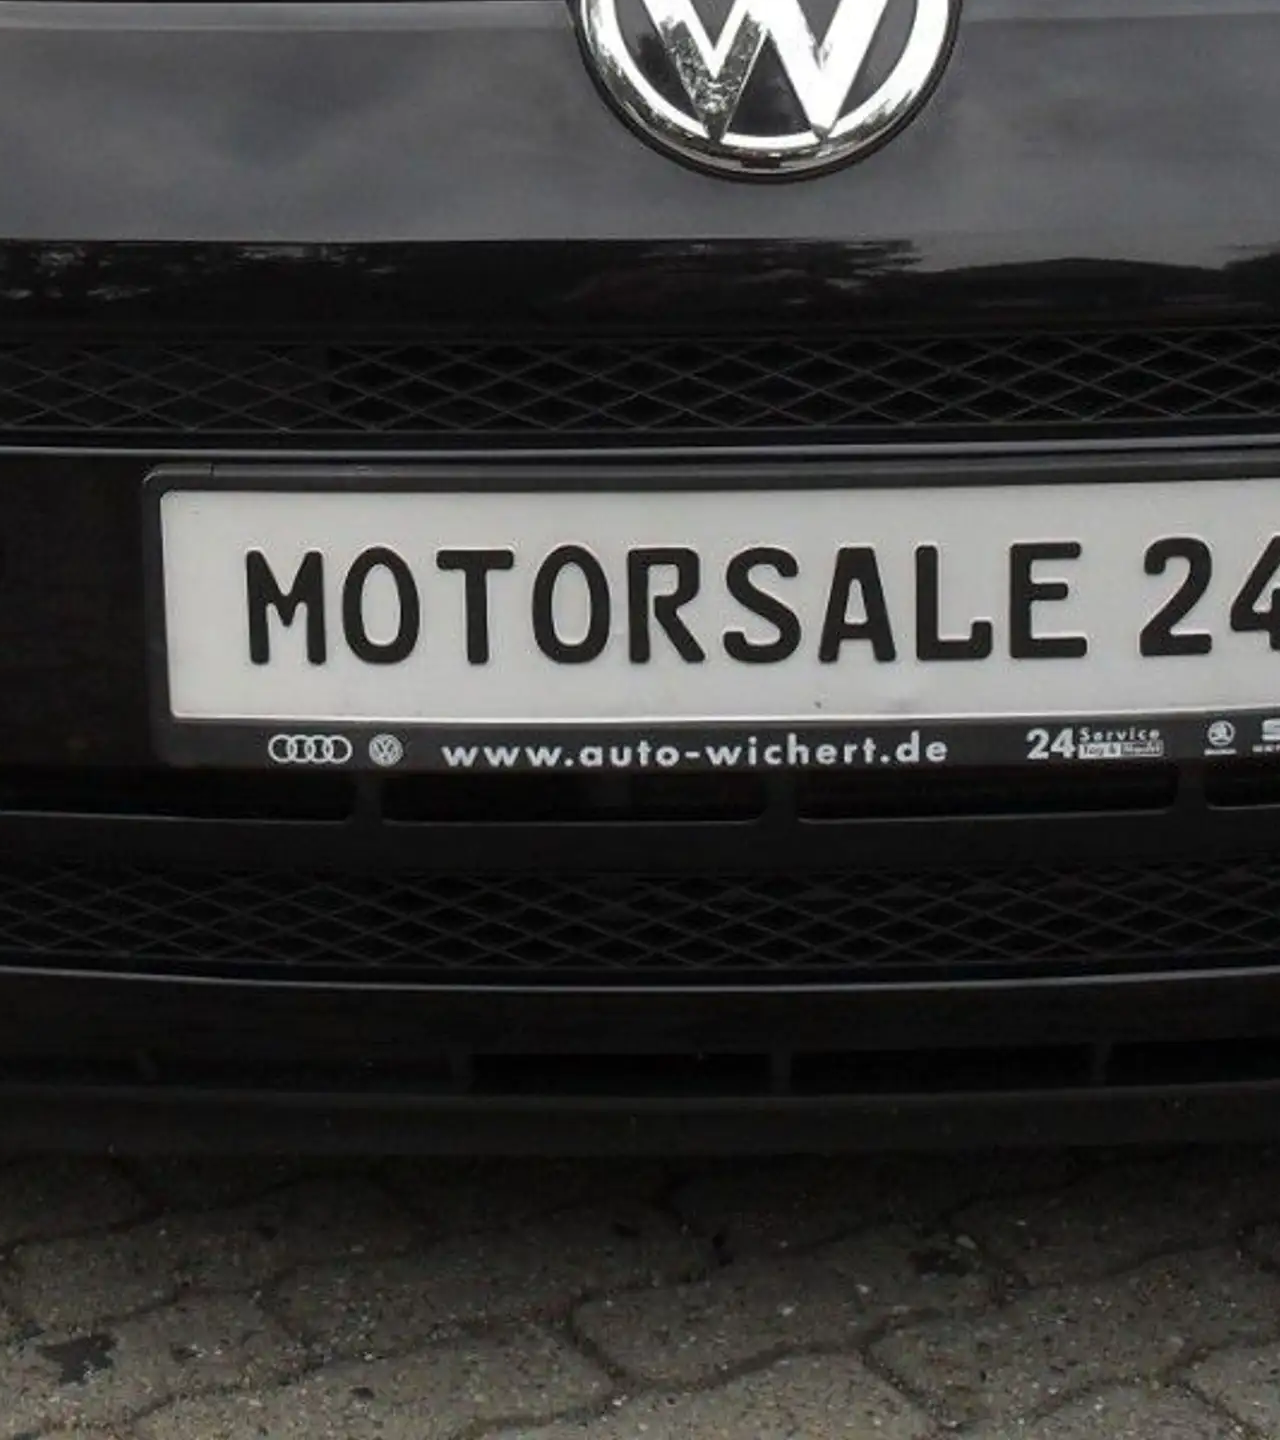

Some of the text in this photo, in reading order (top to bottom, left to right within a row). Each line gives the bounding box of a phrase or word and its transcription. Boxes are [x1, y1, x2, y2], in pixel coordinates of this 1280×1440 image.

[245, 541, 1087, 666] MOTORSALE
[441, 731, 949, 767] www.auto-wichert.de
[1026, 726, 1160, 760] 24 Service
